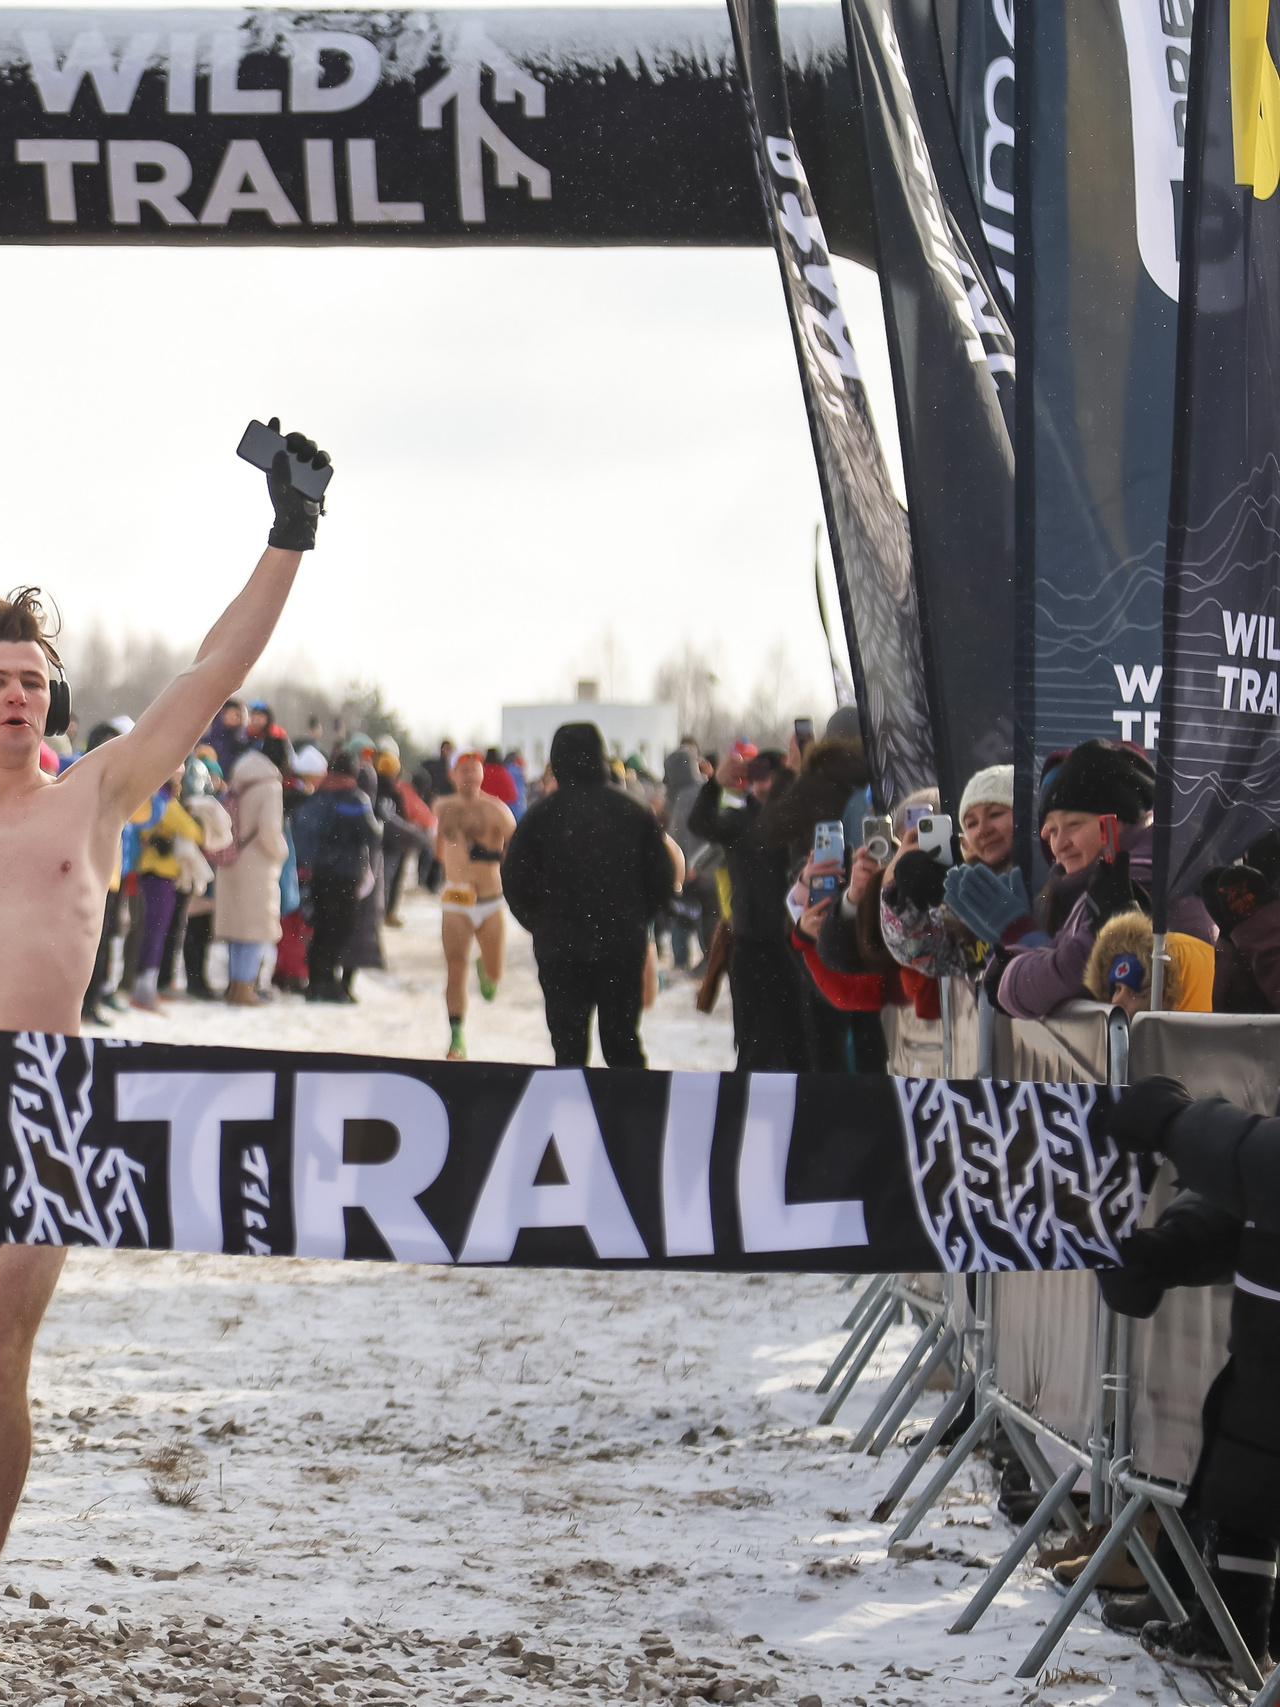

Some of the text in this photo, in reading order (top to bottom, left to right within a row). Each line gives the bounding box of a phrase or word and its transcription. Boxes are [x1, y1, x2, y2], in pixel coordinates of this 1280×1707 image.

[23, 31, 382, 115] WILD
[16, 138, 425, 226] TRAIL
[117, 1067, 868, 1264] TRAIL
